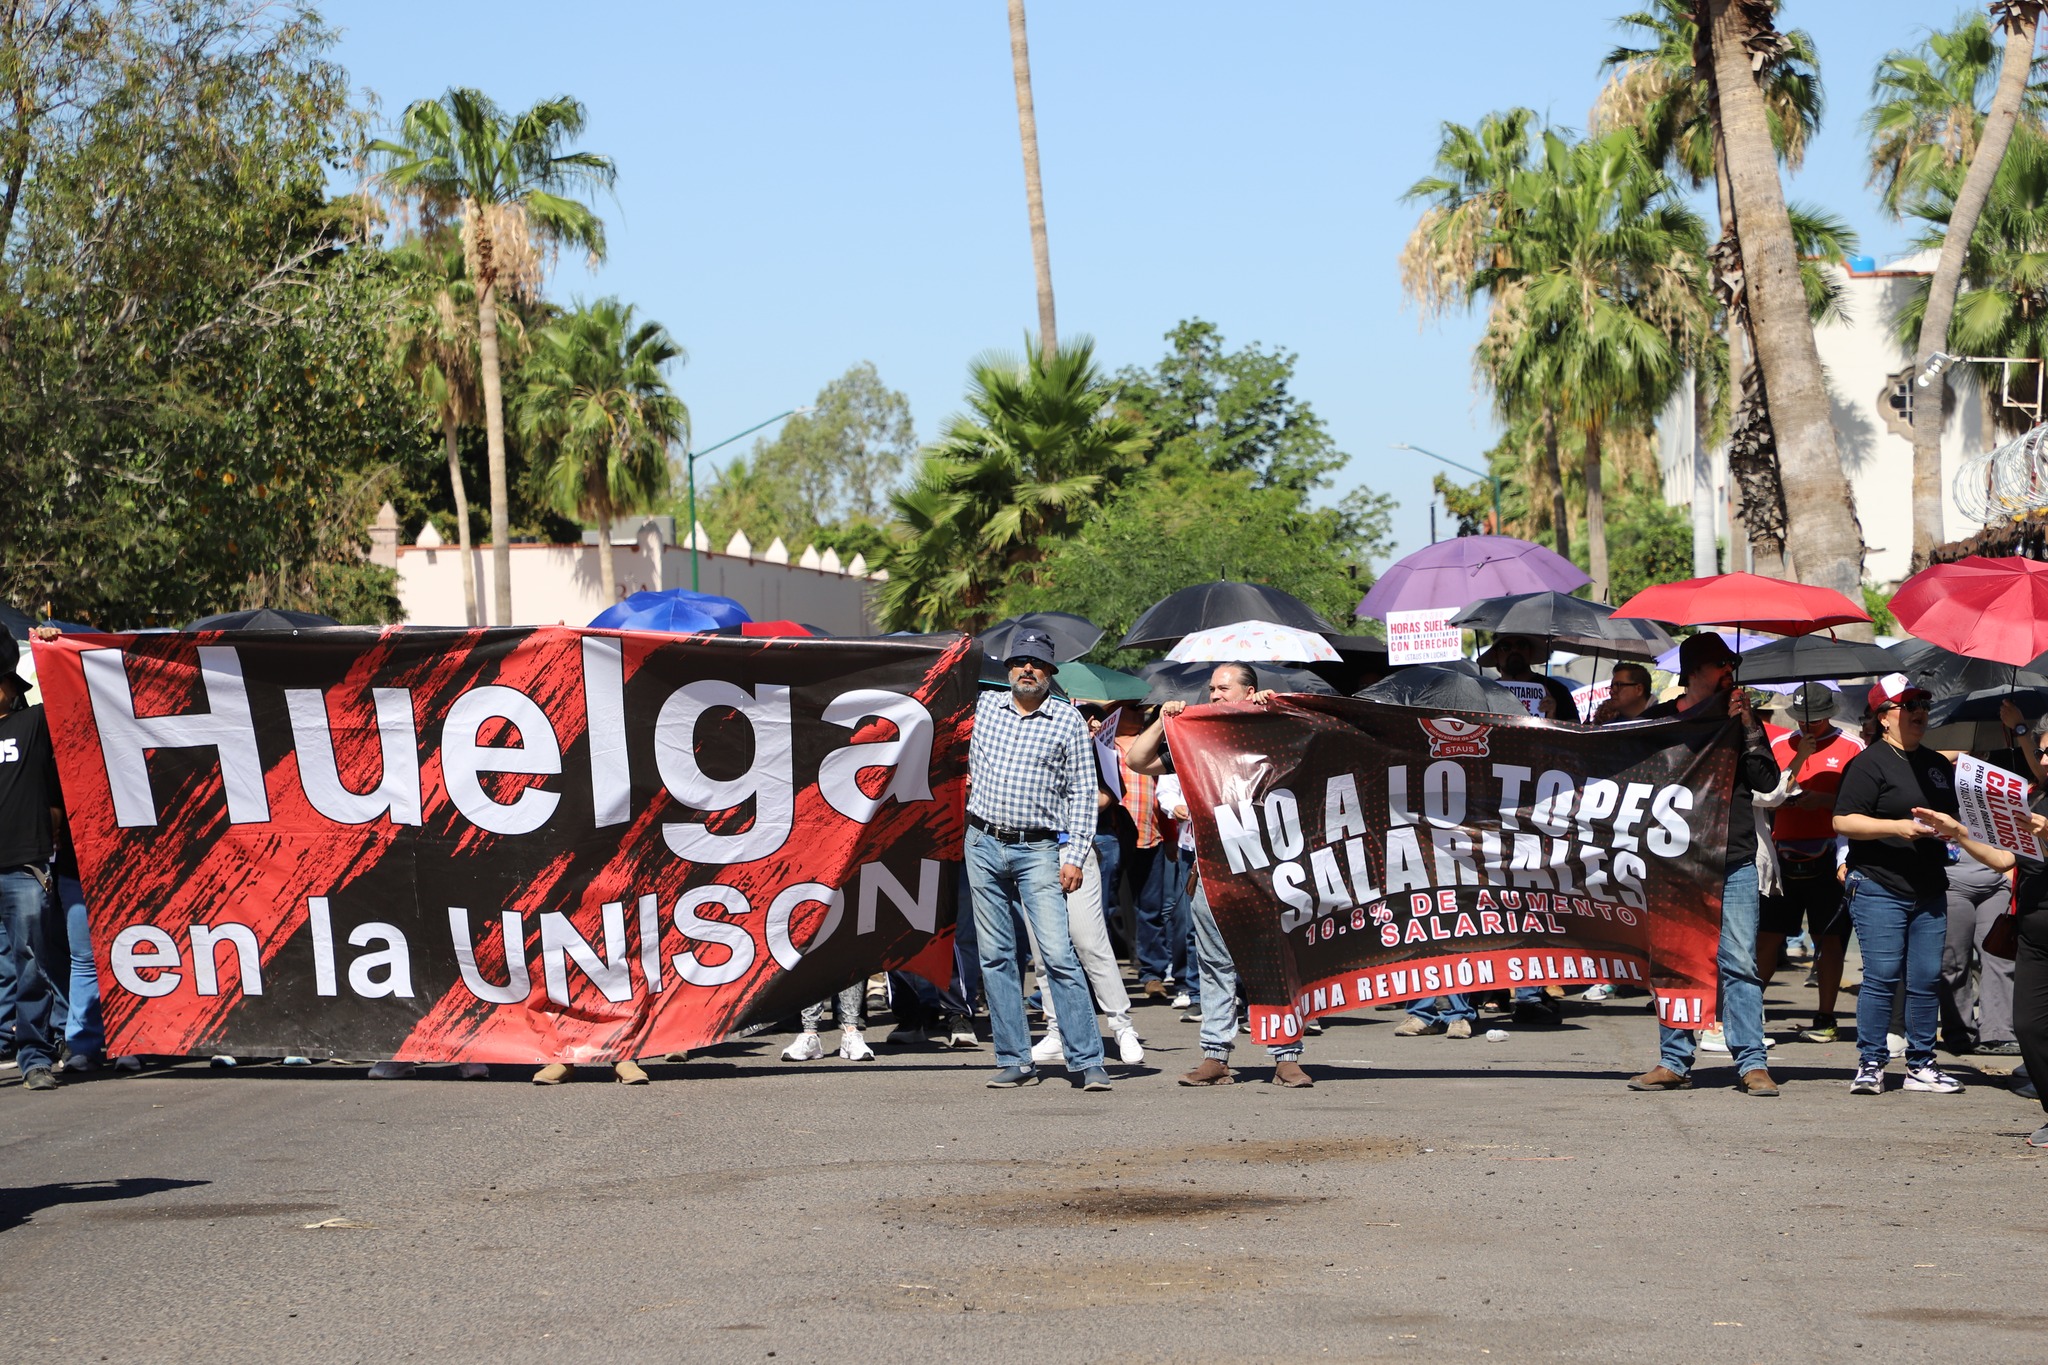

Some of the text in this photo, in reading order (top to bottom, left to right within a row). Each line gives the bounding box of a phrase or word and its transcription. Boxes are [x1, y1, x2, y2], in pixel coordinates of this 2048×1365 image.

[1390, 622, 1421, 635] HORAS
[1391, 637, 1459, 652] CON DERECHOS
[1413, 631, 1458, 639] UNIVERSITARIOS
[79, 635, 935, 865] Huelga
[1428, 727, 1460, 741] universidad
[1445, 746, 1474, 754] STAUS
[1974, 765, 1985, 784] PERO
[1974, 785, 1987, 809] ESTAMOS
[2006, 778, 2024, 807] NOS
[1213, 760, 1694, 874] NO A LO TOPES
[1985, 771, 2020, 850] CALLADOS
[1272, 826, 1648, 934] SALARIALES
[111, 858, 941, 1008] en la UNISON
[1305, 889, 1638, 945] 10.8% DE AUMENTO
[1381, 911, 1566, 947] SALARIAL
[1357, 958, 1494, 1001] REVISIÓN
[1508, 956, 1643, 981] SALARIAL
